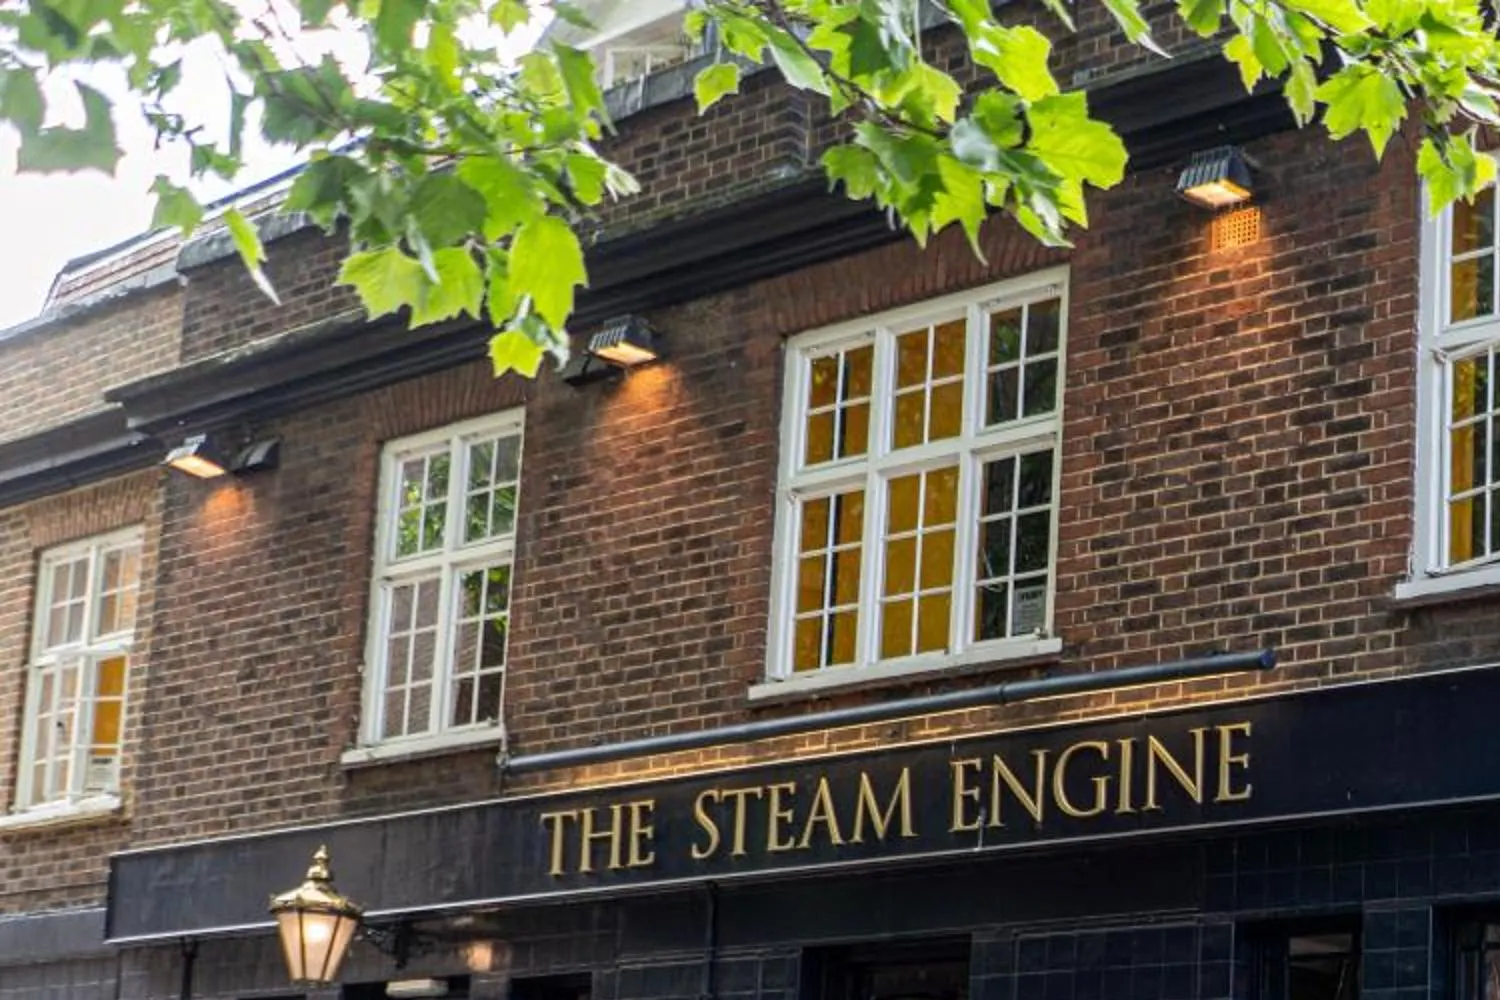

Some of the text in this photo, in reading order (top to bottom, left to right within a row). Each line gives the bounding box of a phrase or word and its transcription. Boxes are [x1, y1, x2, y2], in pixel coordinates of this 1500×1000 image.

[540, 721, 1253, 876] THE STEAM ENGINE
